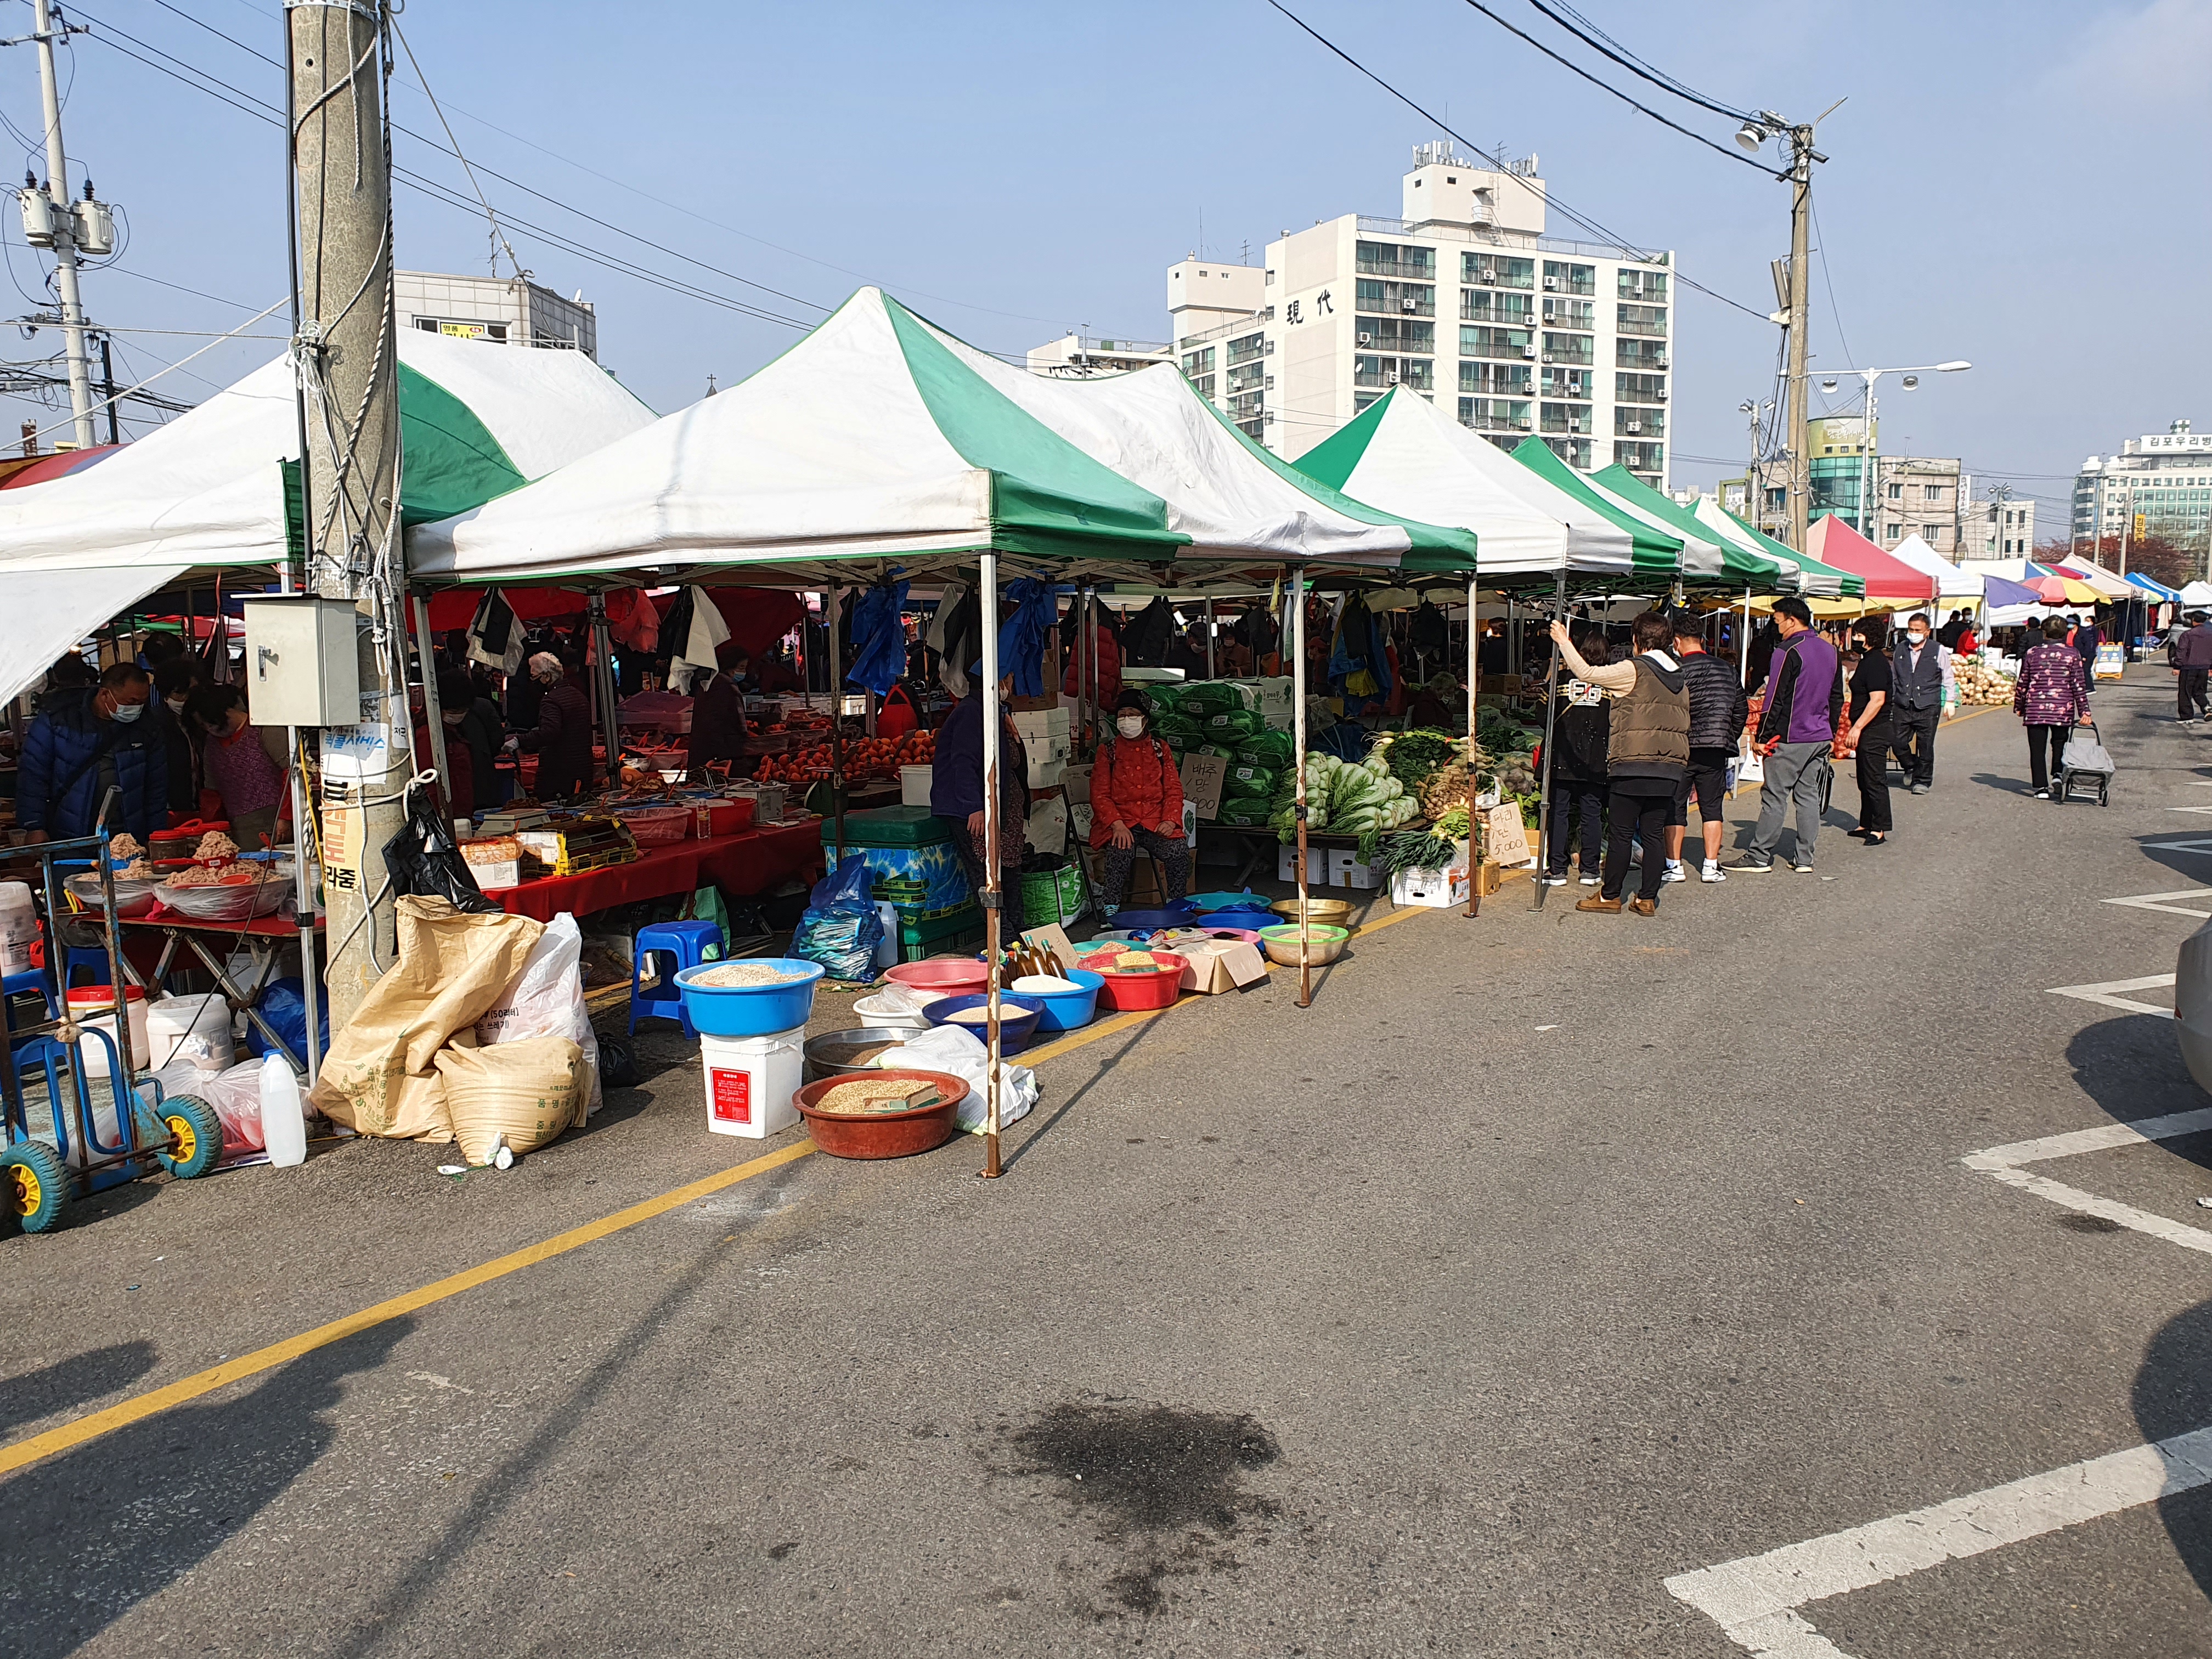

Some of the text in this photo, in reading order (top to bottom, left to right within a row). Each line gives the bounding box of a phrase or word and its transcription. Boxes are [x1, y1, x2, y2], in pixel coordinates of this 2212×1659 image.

[1286, 289, 1334, 325] 現代
[2150, 437, 2212, 447] 김포우리병
[325, 733, 386, 751] 퀵콜서비스
[1192, 763, 1217, 777] 배추
